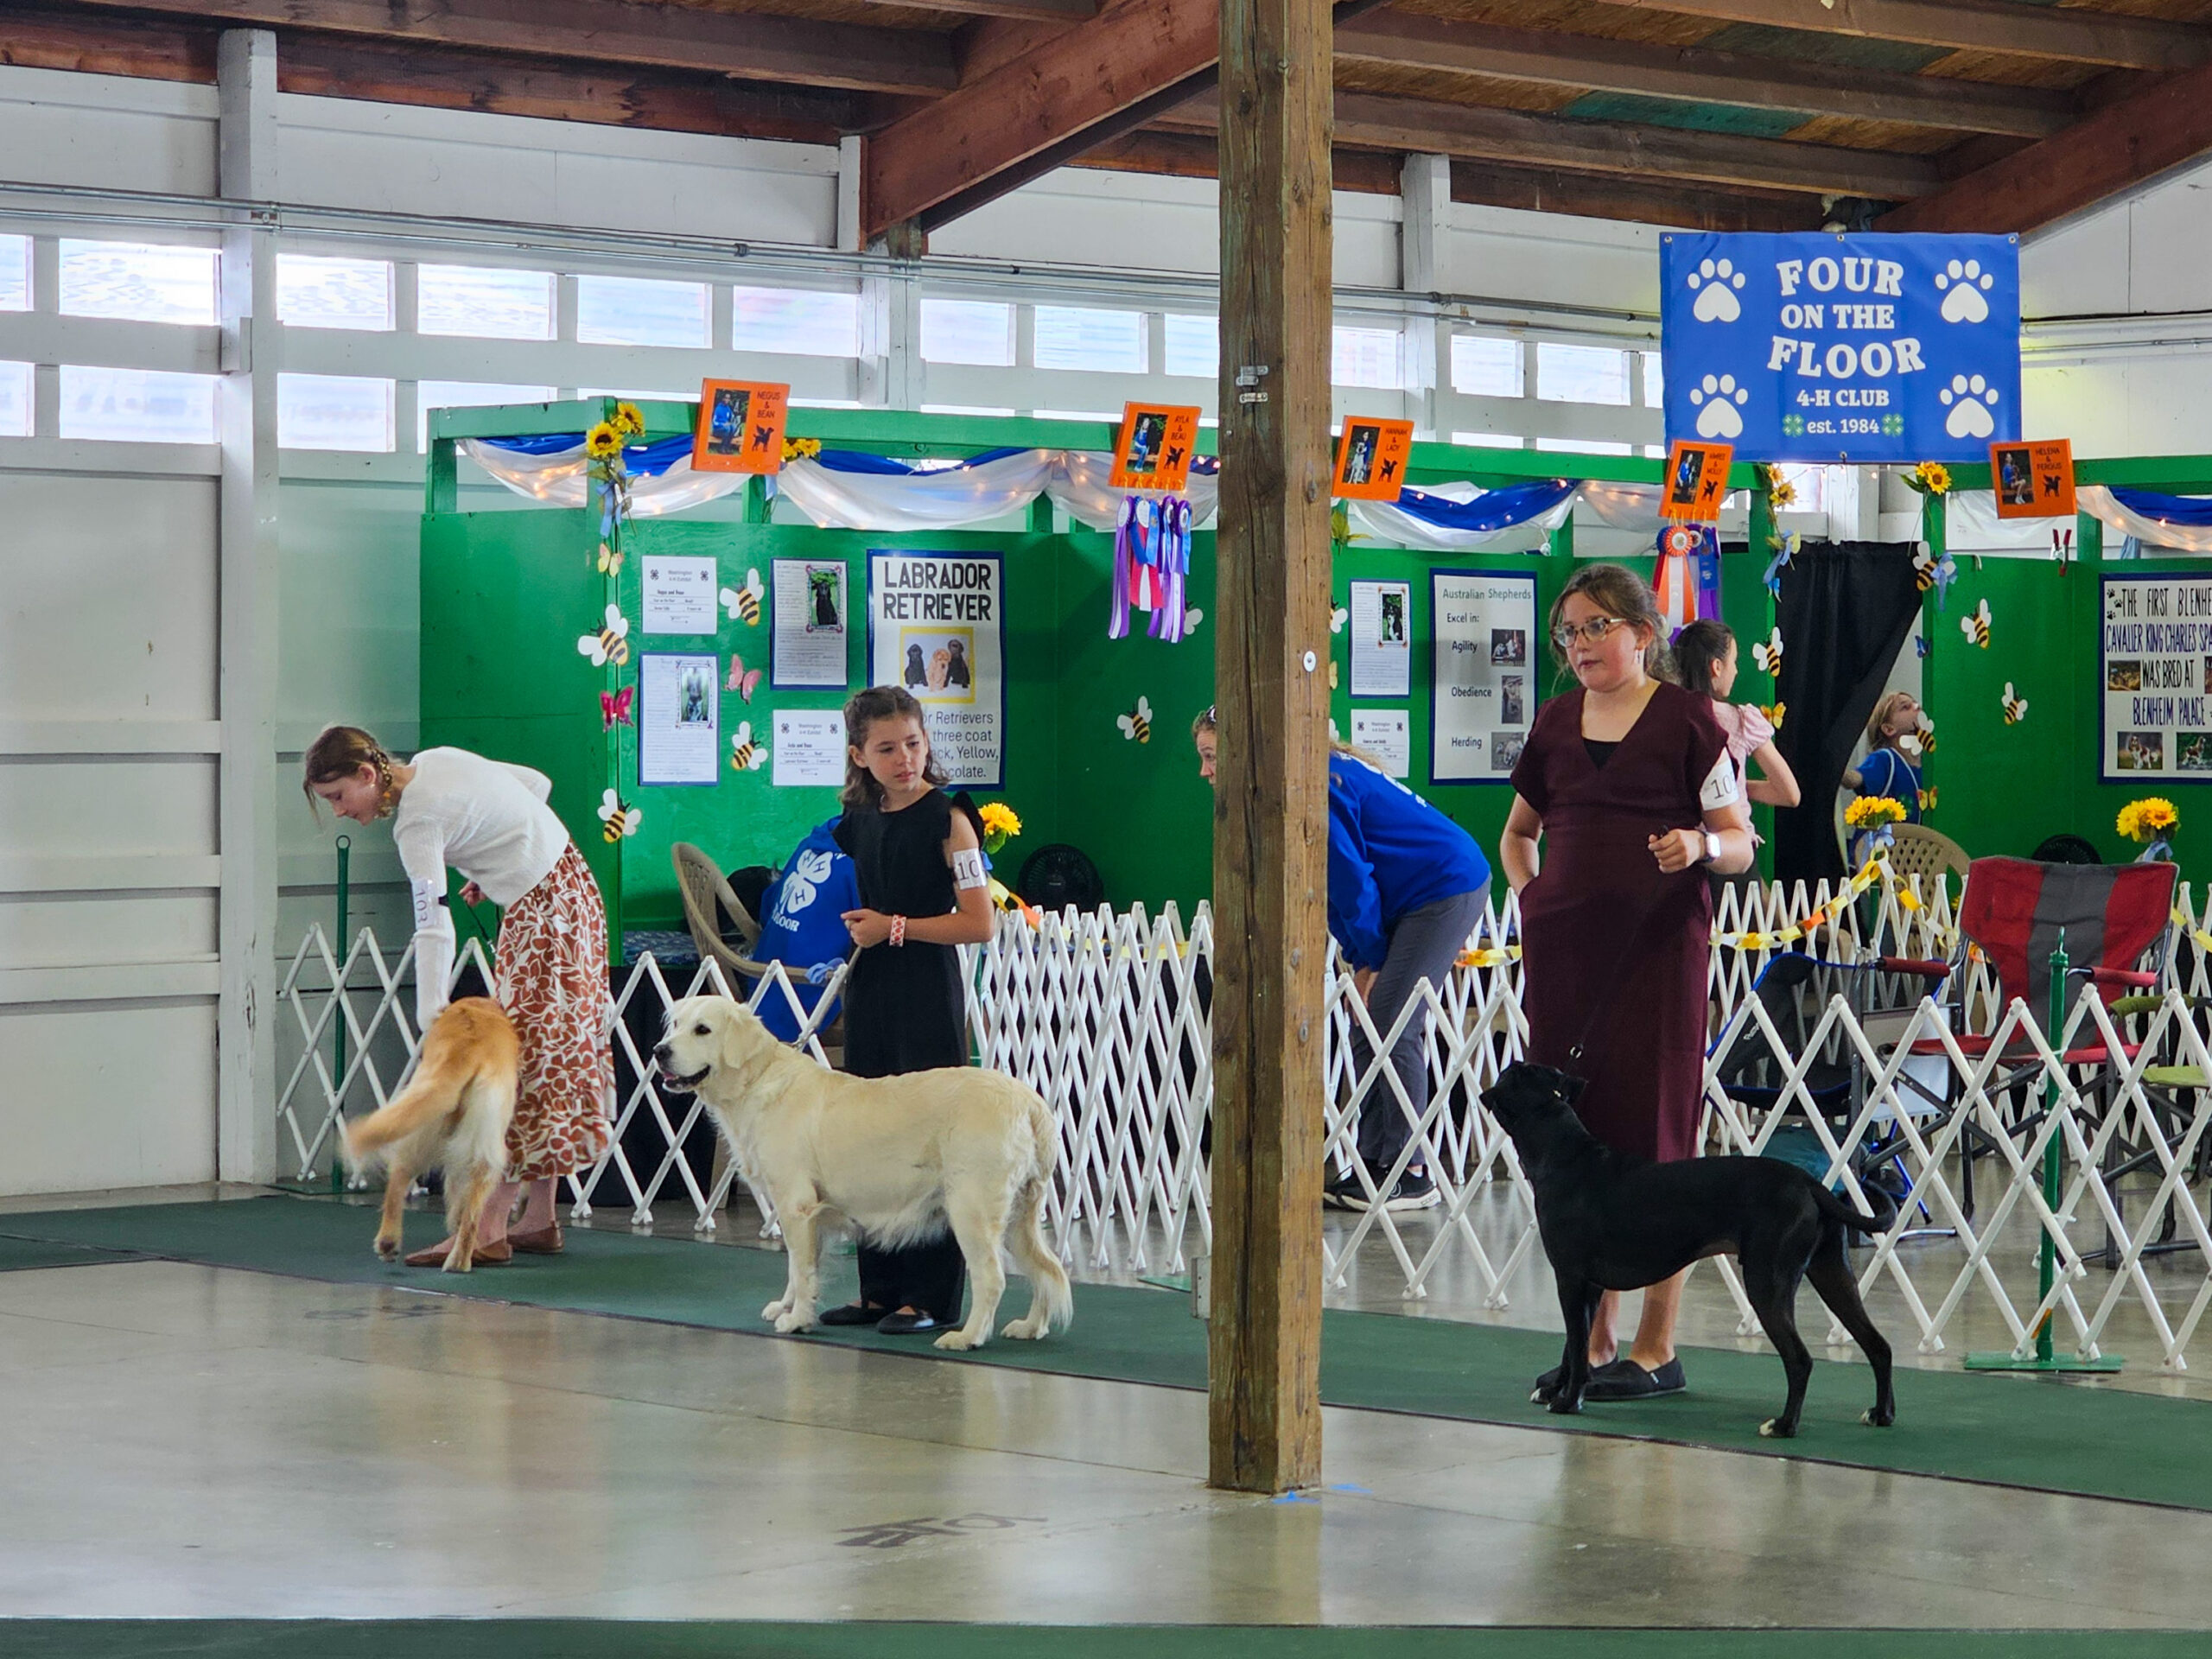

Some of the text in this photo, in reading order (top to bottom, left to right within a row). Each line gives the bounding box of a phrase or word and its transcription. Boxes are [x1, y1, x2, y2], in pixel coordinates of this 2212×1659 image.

[1776, 257, 1904, 296] FOUR
[1780, 303, 1895, 330] ON THE
[1767, 334, 1927, 379] FLOOR
[1796, 389, 1890, 407] 4-H CLUB
[756, 410, 775, 419] BEAN
[1807, 418, 1880, 434] est. 1984
[884, 561, 992, 590] LABRADOR
[1442, 588, 1532, 601] Australian Shepherds
[2121, 588, 2138, 618] THE
[2147, 588, 2169, 618] FIRST
[883, 592, 992, 621] RETRIEVER
[1446, 613, 1479, 623] Excel in:
[1452, 640, 1478, 653] Agility
[2106, 624, 2143, 653] CAVALIER
[2146, 624, 2163, 653] KING
[2165, 624, 2197, 652] CHARLES
[2143, 659, 2195, 689] WAS BRED AT
[1451, 687, 1492, 697] Obedience
[936, 710, 994, 725] Retrievers
[2133, 696, 2205, 727] BLENHEIM PALACE
[933, 728, 993, 742] three coat
[1452, 737, 1482, 749] Herding
[957, 745, 999, 762] Yellow,
